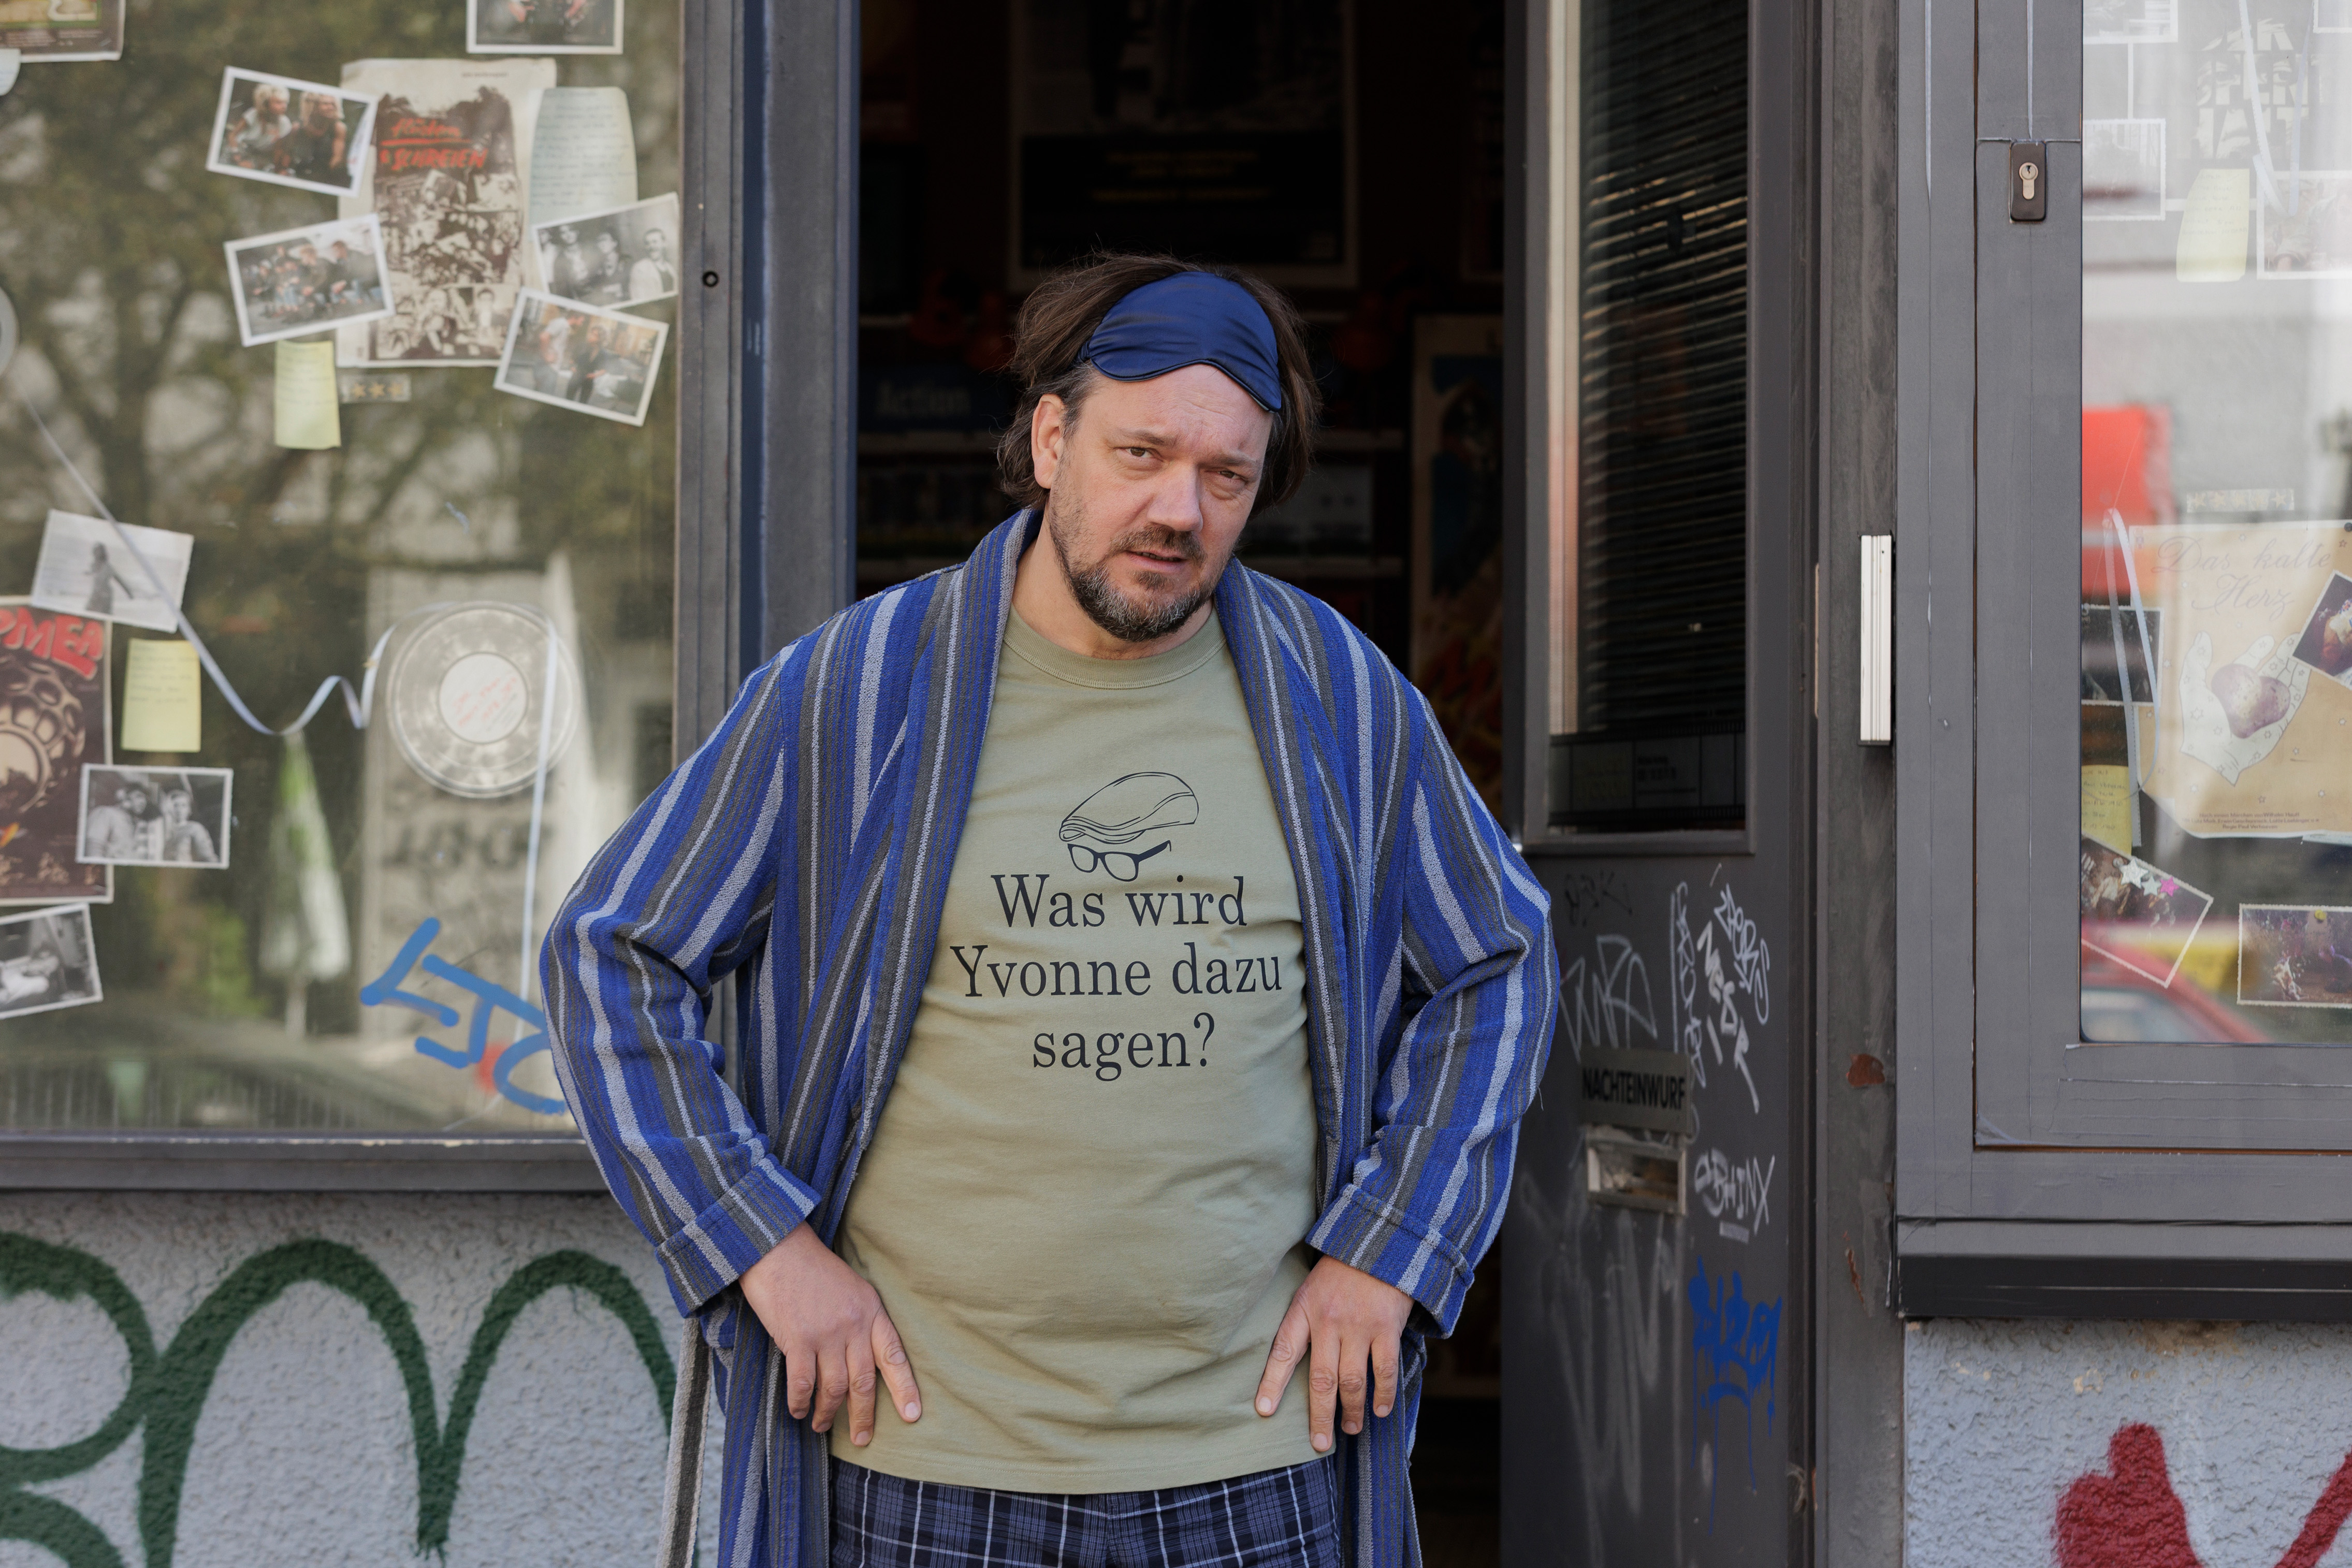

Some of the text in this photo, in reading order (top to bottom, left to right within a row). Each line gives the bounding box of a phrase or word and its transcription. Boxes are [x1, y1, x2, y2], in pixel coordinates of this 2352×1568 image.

[2151, 535, 2331, 573] Das kalte
[2191, 573, 2296, 622] Herz
[990, 874, 1247, 927] Was wird
[949, 942, 1283, 997] Yvonne dazu
[1033, 1012, 1215, 1082] sagen?
[1582, 1067, 1686, 1110] NACHTEINWURF
